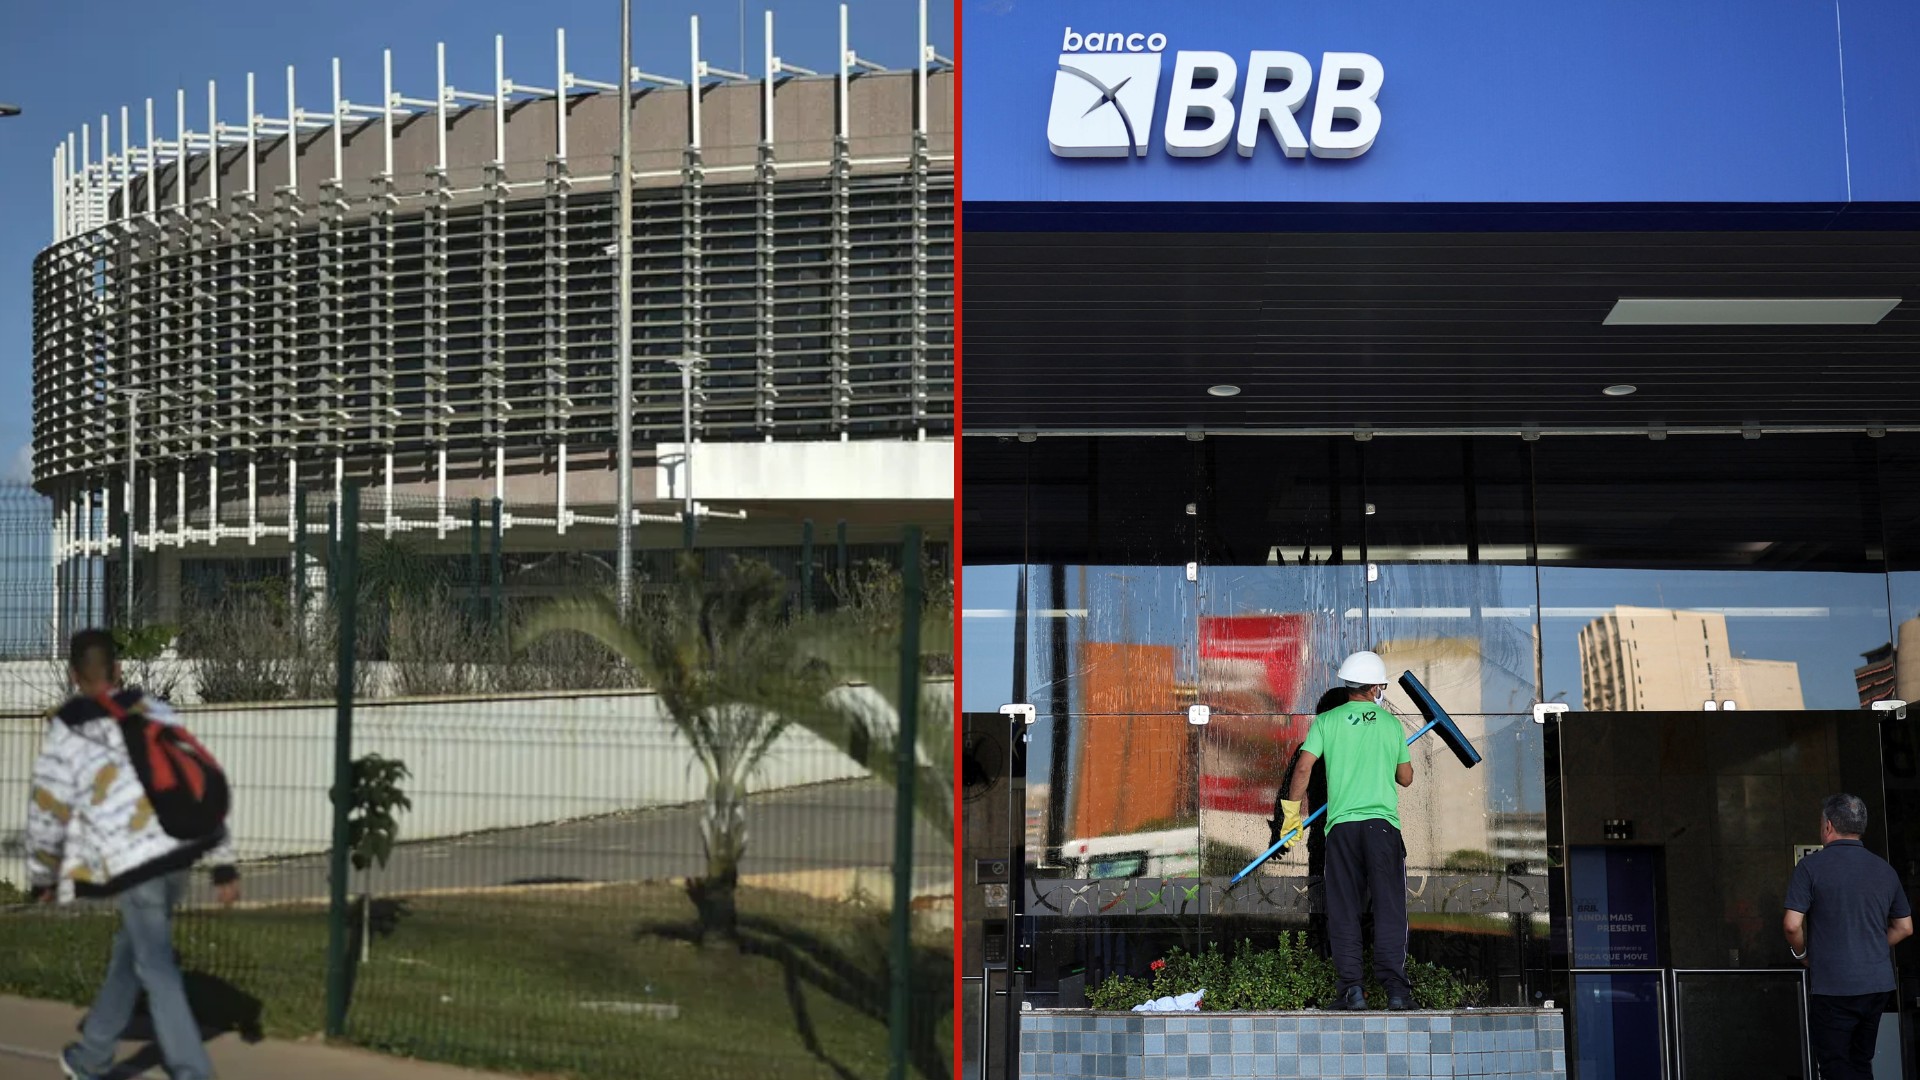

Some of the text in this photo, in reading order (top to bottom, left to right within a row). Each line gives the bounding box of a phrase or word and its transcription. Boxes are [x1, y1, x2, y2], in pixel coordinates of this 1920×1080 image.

[1062, 26, 1167, 52] banco
[1164, 49, 1385, 159] BRB
[1362, 711, 1377, 721] K2
[1577, 913, 1633, 921] AINDA MAIS
[1597, 924, 1647, 932] PRESENTE
[1602, 953, 1620, 962] QUE
